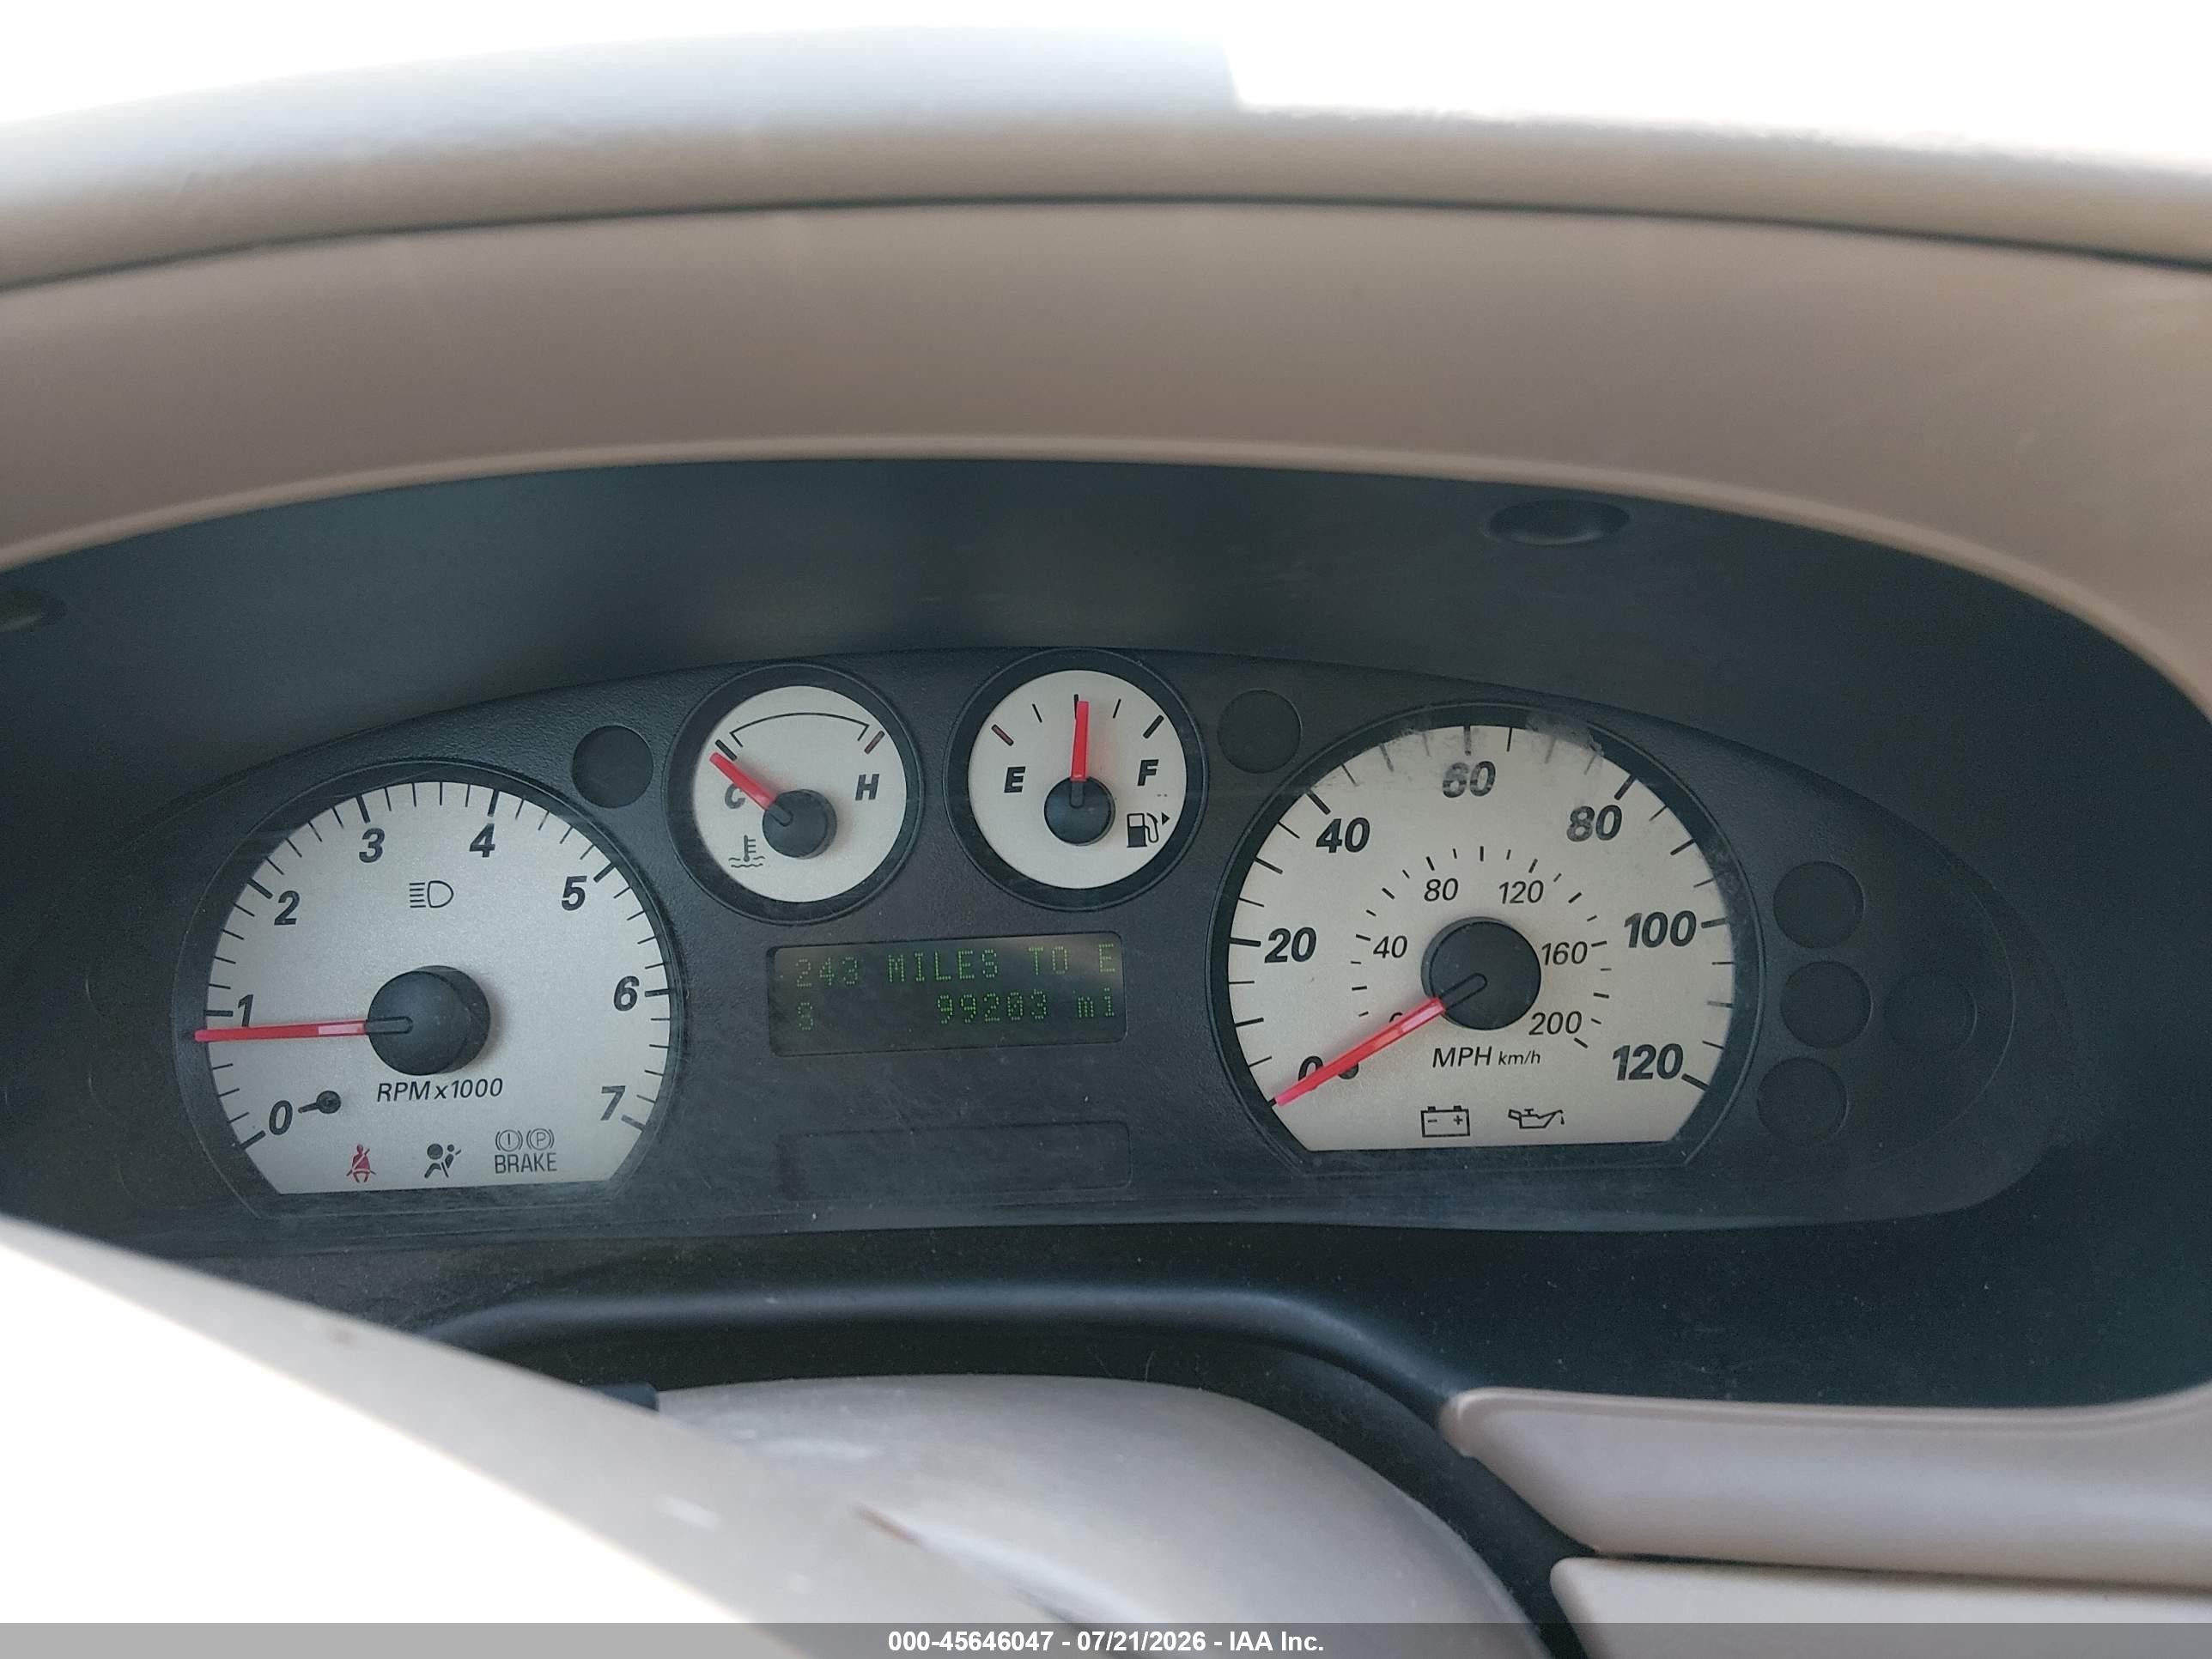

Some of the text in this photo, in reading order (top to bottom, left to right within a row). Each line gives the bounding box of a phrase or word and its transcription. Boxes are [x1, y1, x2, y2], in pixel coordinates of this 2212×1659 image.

[854, 774, 879, 801] H
[1004, 766, 1026, 793] E
[1138, 759, 1159, 787] F
[1442, 760, 1496, 798] 60
[470, 823, 495, 858] 4
[1316, 817, 1370, 854] 40
[1566, 805, 1622, 842] 80
[358, 827, 386, 863] 3
[561, 875, 587, 911] 5
[1424, 878, 1459, 902] 80
[1499, 878, 1544, 904] 120
[274, 890, 301, 926] 2
[1264, 927, 1316, 963] 20
[1623, 910, 1697, 949] 100
[1372, 936, 1408, 959] 40
[1541, 941, 1589, 965] 160
[795, 943, 1116, 988] 243 MILES TO E
[237, 994, 255, 1027] 1
[613, 975, 640, 1012] 6
[937, 989, 1048, 1024] 99203
[1078, 987, 1115, 1018] mi
[1528, 1011, 1583, 1036] 200
[1432, 1046, 1540, 1067] MPH km/h
[1612, 1042, 1684, 1081] 120
[268, 1100, 293, 1135] 0
[601, 1085, 627, 1121] 7
[495, 1152, 557, 1174] BRAKE
